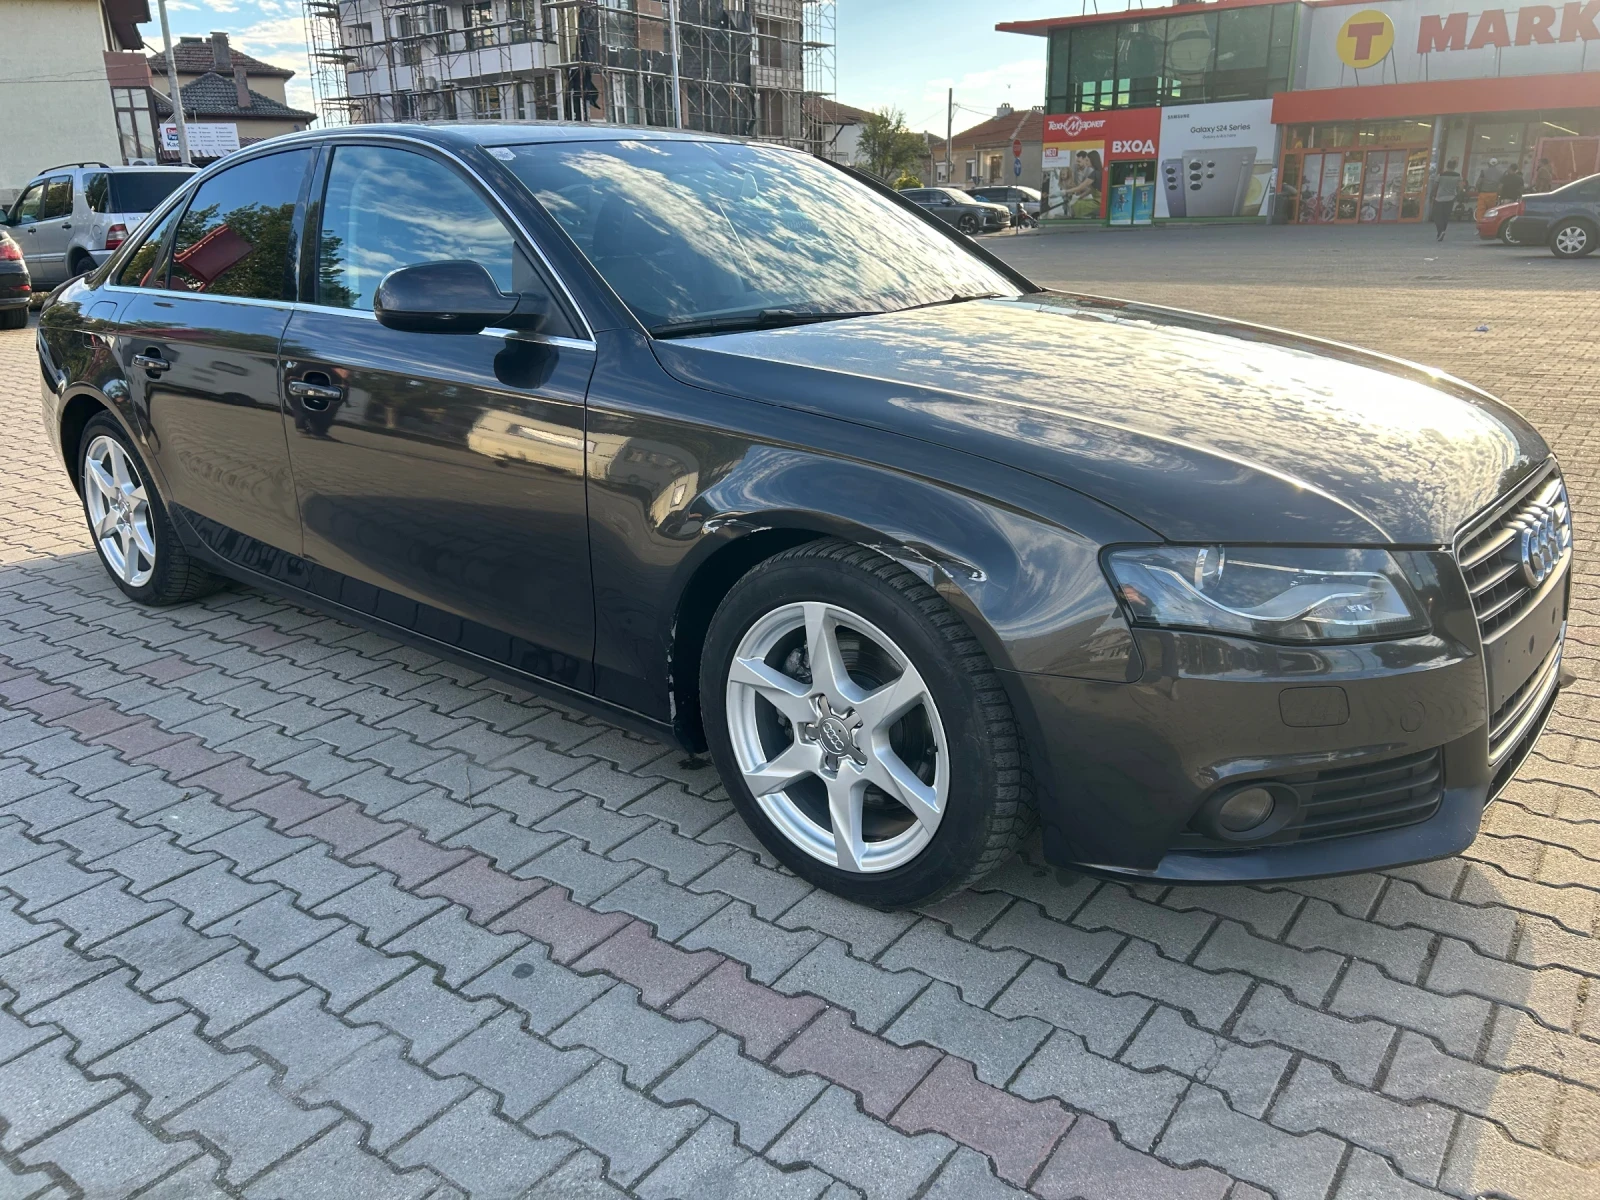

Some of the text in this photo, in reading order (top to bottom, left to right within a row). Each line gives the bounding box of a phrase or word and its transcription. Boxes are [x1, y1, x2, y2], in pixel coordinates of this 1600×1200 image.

[1417, 0, 1600, 54] MARK
[1190, 123, 1251, 134] Galaxy S24 Series
[1111, 139, 1155, 155] ВХОД
